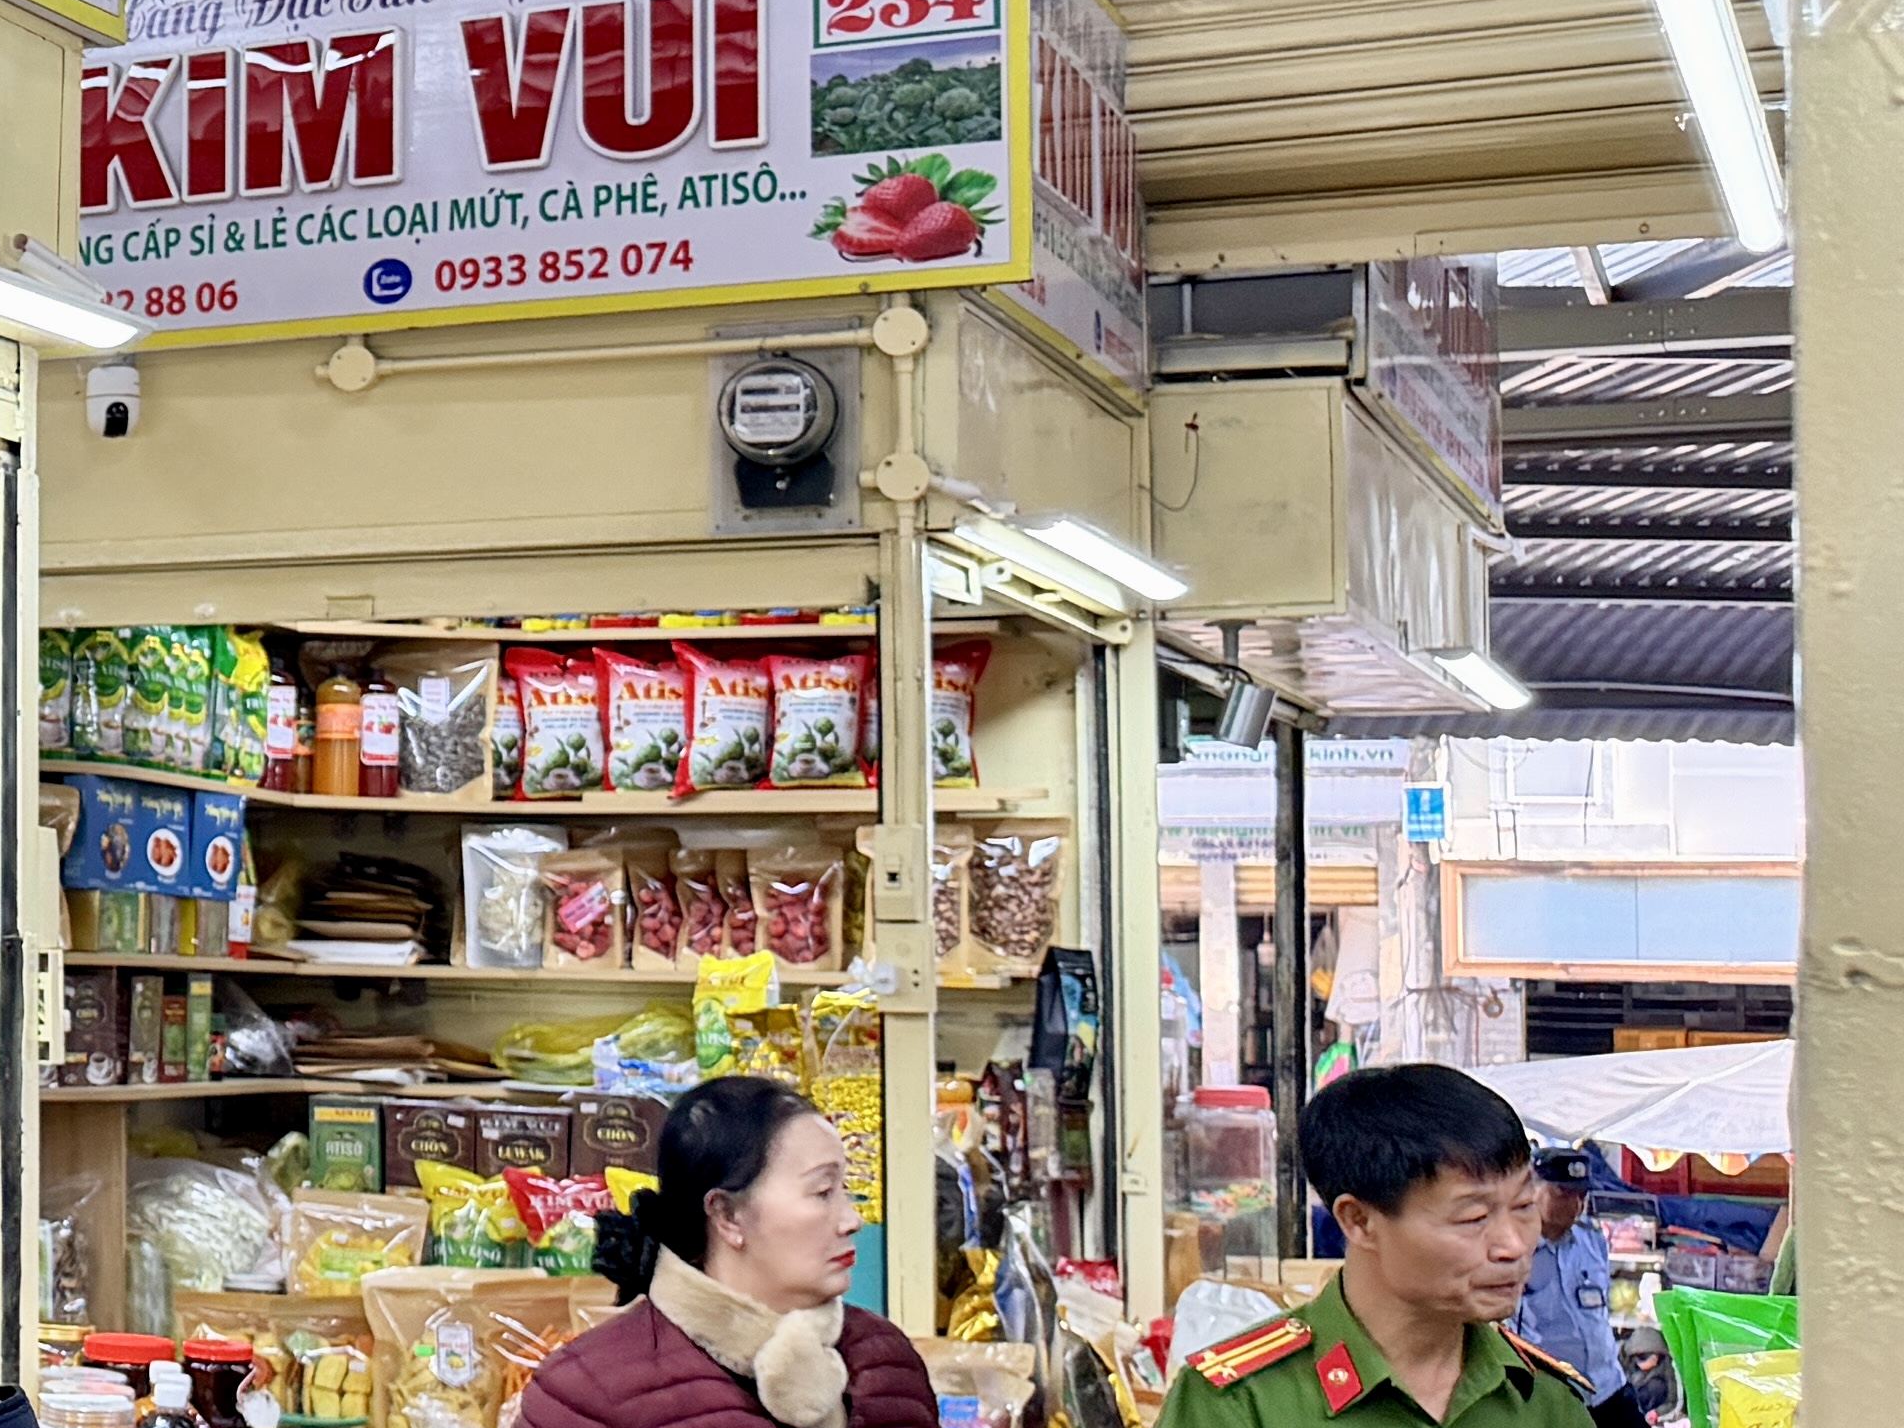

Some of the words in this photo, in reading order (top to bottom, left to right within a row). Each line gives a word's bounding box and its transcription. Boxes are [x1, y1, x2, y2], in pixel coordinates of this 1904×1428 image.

[80, 28, 400, 212] KIM
[79, 234, 113, 266] NG
[123, 219, 181, 261] CẤP
[190, 213, 215, 257] SỈ
[224, 221, 243, 253] &
[253, 207, 288, 251] LẺ
[296, 205, 357, 246] CÁC
[367, 201, 438, 244] LOẠI
[450, 186, 530, 232] MỨT,
[539, 181, 583, 222] CÀ
[593, 174, 668, 218] PHÊ,
[677, 162, 807, 210] ATISÔ...
[144, 284, 186, 318] 88
[195, 279, 238, 313] 06
[434, 254, 527, 292] 0933
[538, 246, 609, 283] 852
[620, 239, 694, 277] 074
